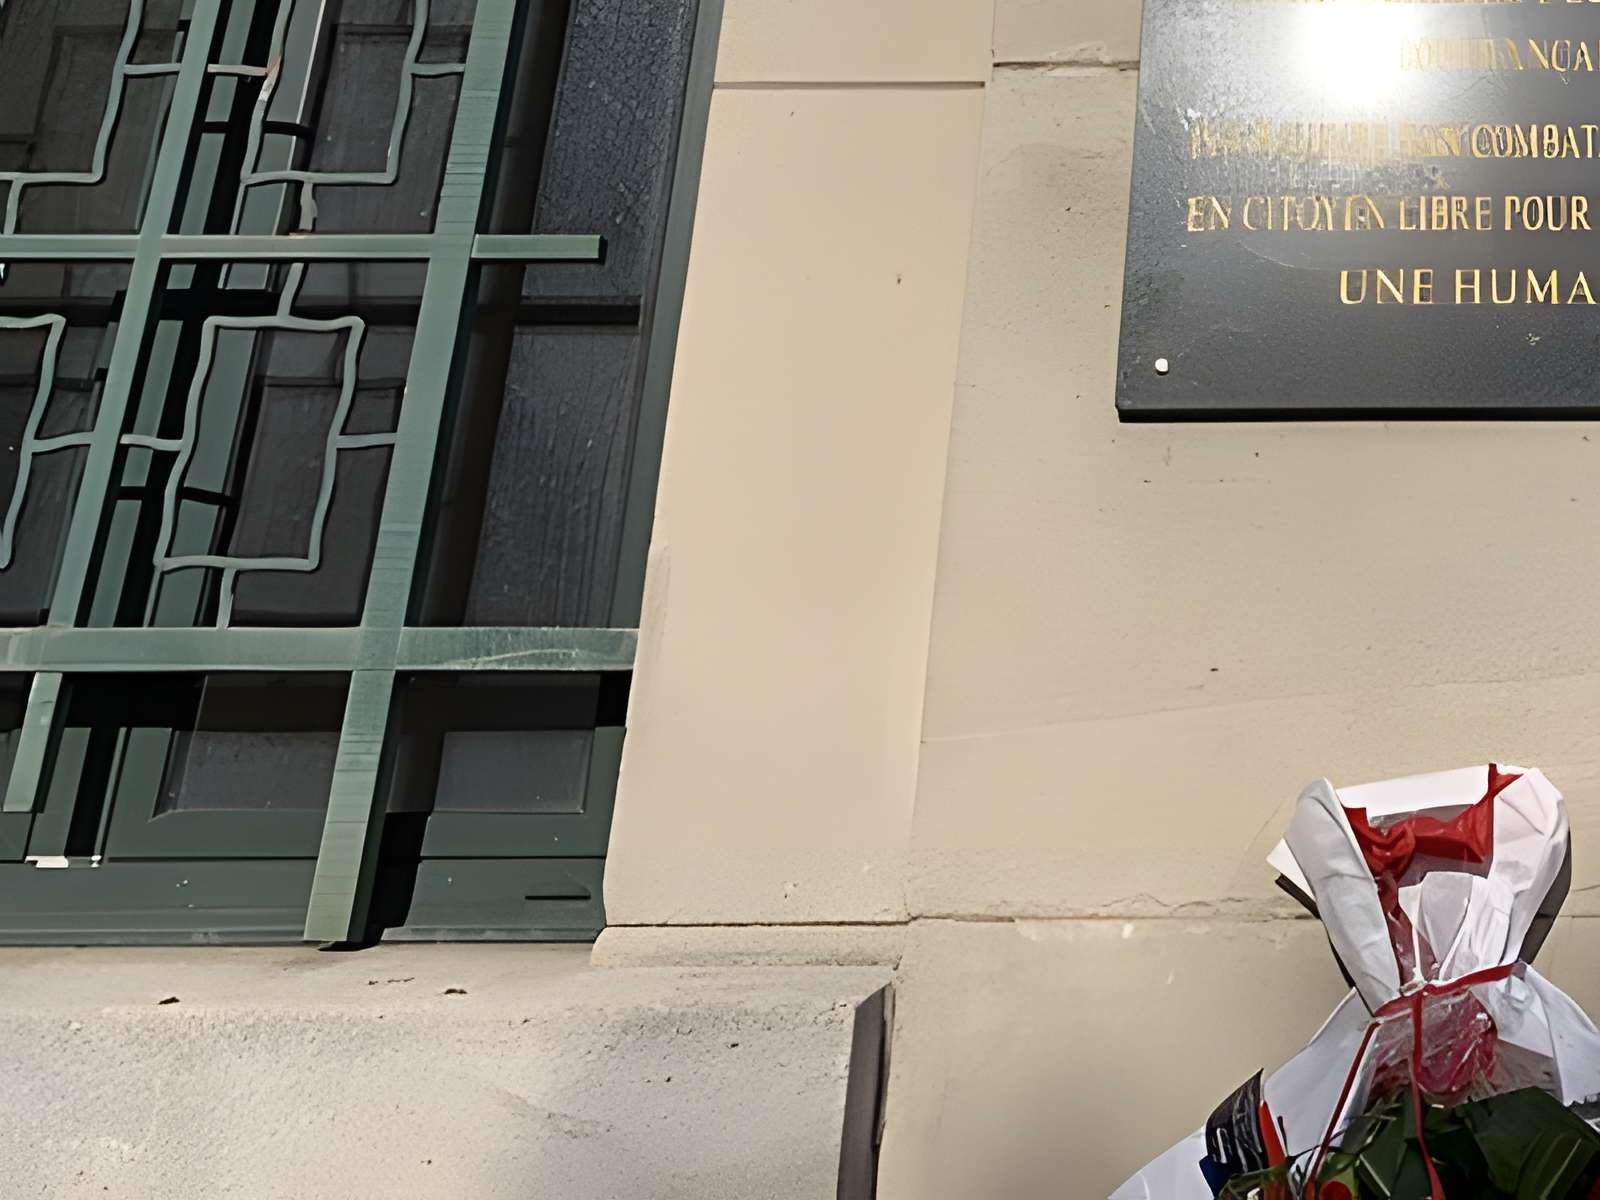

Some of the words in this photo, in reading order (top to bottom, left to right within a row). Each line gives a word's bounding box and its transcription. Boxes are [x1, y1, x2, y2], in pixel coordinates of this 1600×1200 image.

[1187, 195, 1231, 232] EN
[1398, 195, 1494, 232] LIBRE
[1503, 195, 1593, 232] POUR
[1338, 269, 1434, 305] UNE
